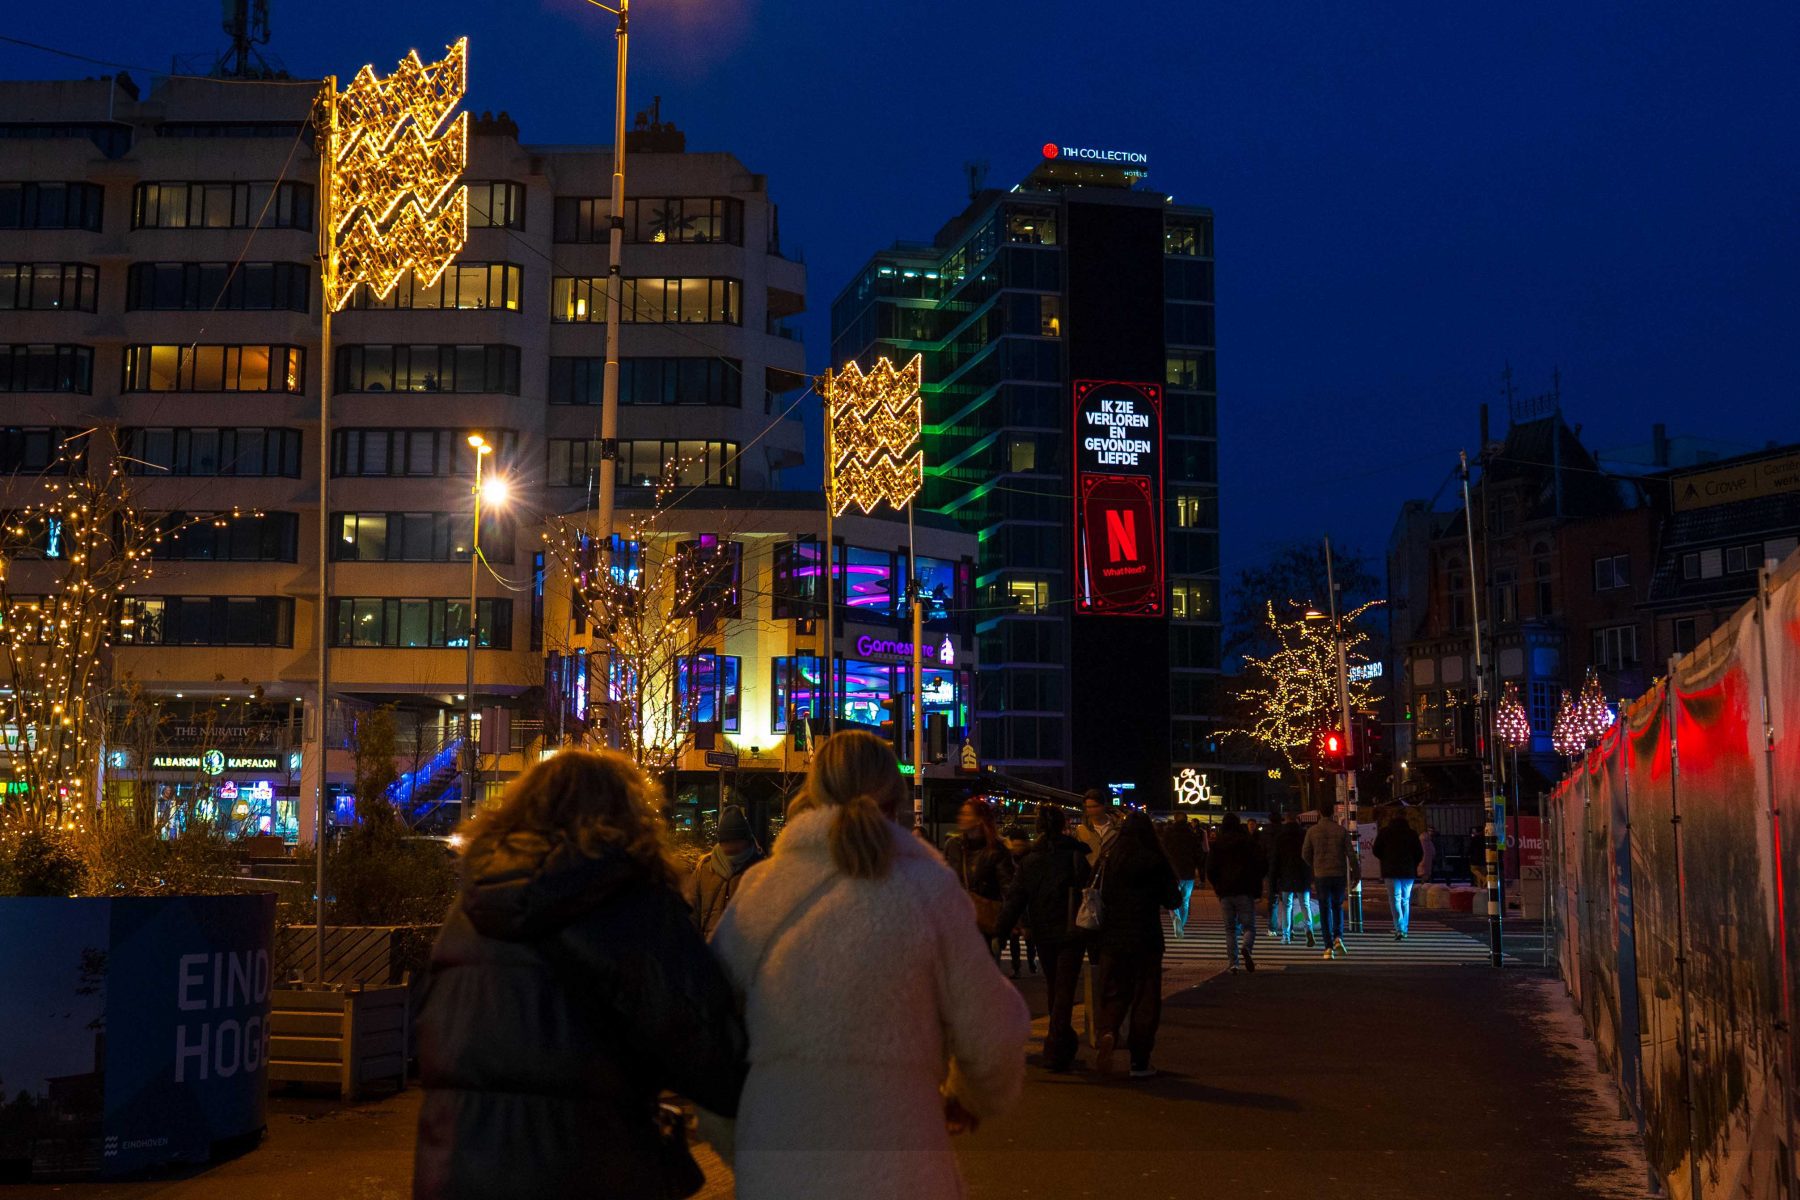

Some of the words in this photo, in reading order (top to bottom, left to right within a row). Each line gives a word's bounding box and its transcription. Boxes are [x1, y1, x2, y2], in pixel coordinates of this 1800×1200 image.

[1080, 148, 1147, 163] COLLECTION
[1123, 169, 1148, 178] HOTELS
[1101, 400, 1113, 413] IK
[1115, 401, 1134, 414] ZIE
[1085, 412, 1149, 428] VERLOREN
[1109, 426, 1126, 439] EN
[1084, 437, 1151, 453] GEVONDEN
[1098, 451, 1138, 466] LIEFDE
[1705, 478, 1747, 496] Crowe
[1103, 568, 1123, 577] What
[174, 727, 197, 736] THE
[153, 757, 200, 767] ALBARON
[228, 758, 277, 769] KAPSALON
[121, 1136, 169, 1150] EINDHOVEN
